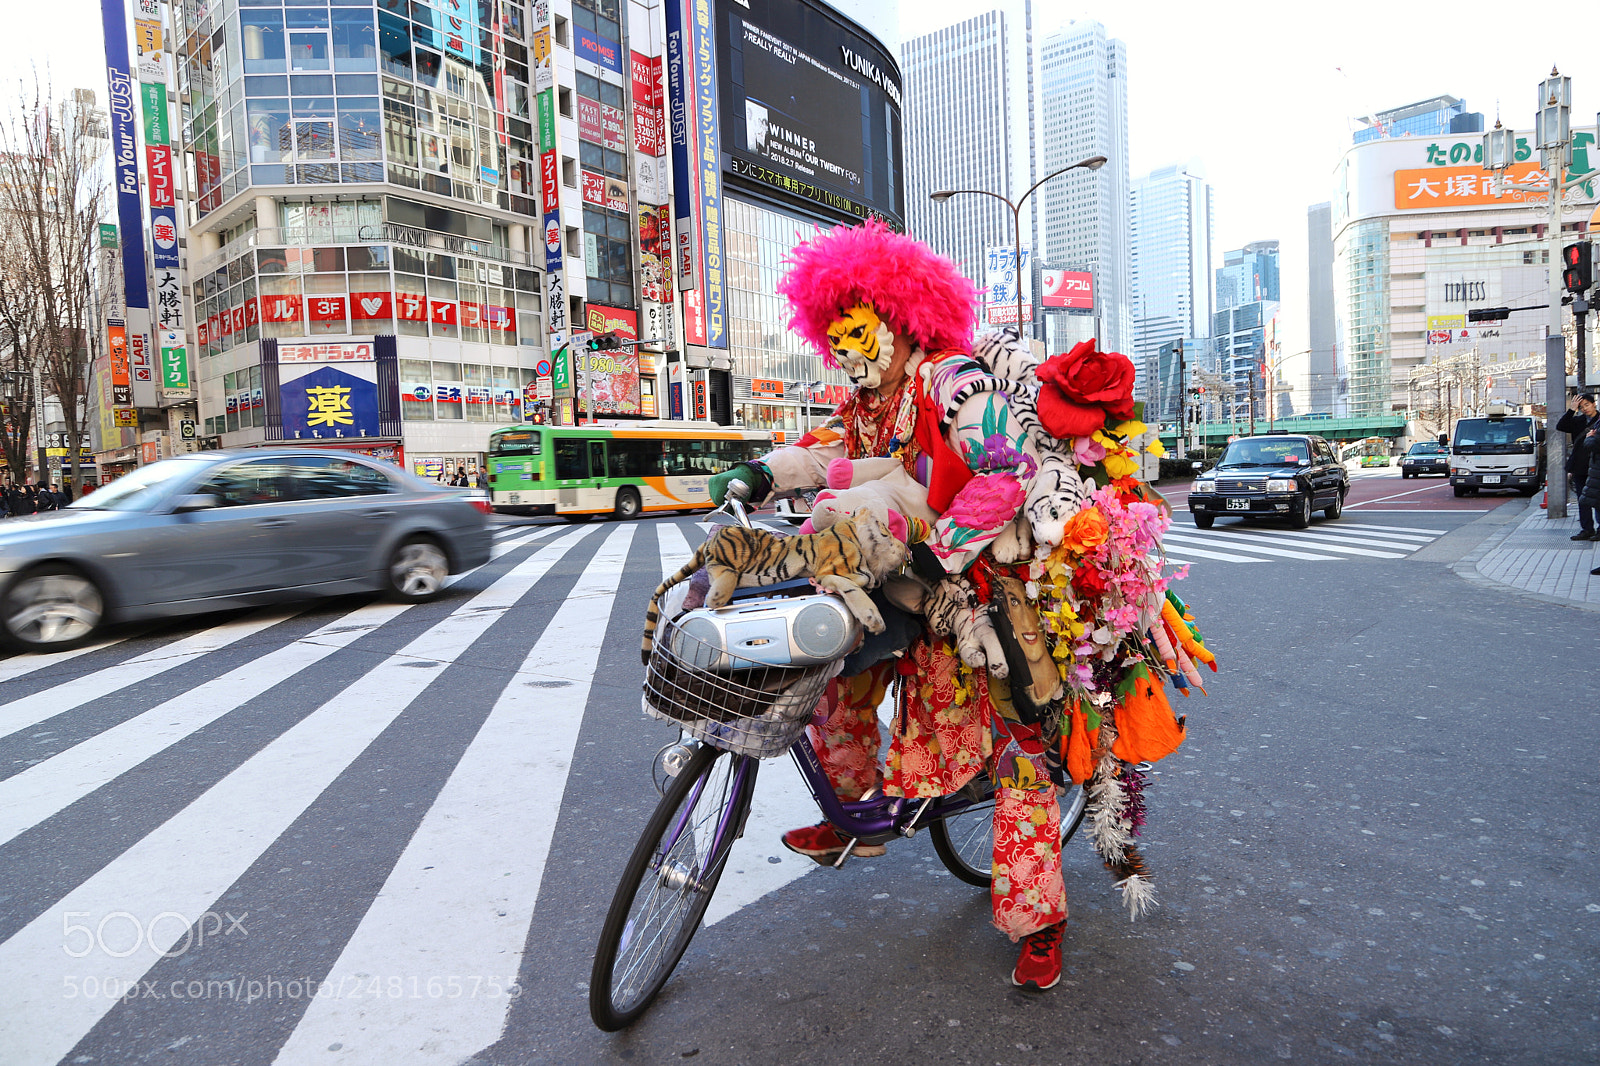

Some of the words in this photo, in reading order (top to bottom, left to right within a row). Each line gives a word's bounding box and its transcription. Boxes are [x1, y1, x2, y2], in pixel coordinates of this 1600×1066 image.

[581, 37, 615, 60] PROMISE
[668, 30, 680, 55] For
[748, 32, 773, 52] REALLY
[773, 46, 797, 65] REALLY
[632, 61, 650, 75] FAST
[841, 45, 882, 87] YUNIKA
[632, 72, 651, 86] NAIL
[108, 67, 134, 122] JUST
[580, 104, 599, 116] FAST
[581, 113, 599, 126] NAIL
[602, 105, 624, 120] ネイル
[670, 97, 686, 146] JUST
[645, 117, 654, 128] 03
[656, 108, 665, 155] まつげ本舗
[768, 122, 816, 153] WINNER
[769, 139, 783, 152] NEW
[783, 145, 802, 159] ALBUM
[819, 158, 845, 177] TWENTY
[794, 161, 815, 176] Release
[119, 171, 138, 195] For
[151, 149, 171, 203] アイフル
[544, 154, 557, 208] アイフル
[582, 173, 605, 190] まつげ
[585, 188, 602, 203] 本舗
[155, 224, 174, 241] 薬
[546, 228, 560, 245] 薬
[683, 247, 691, 276] LABI
[988, 247, 1029, 271] カラオケ
[1004, 270, 1013, 282] の
[1066, 279, 1091, 291] アコム
[158, 271, 183, 327] 大勝軒
[549, 273, 566, 329] 大勝軒
[993, 283, 1026, 303] 鉄人
[1063, 298, 1073, 306] 2F
[1445, 276, 1485, 308] TIPNESS
[317, 301, 340, 315] 3F
[403, 298, 511, 328] アイフル
[131, 334, 145, 366] LABI
[168, 350, 182, 382] レイク
[556, 355, 565, 384] レイク
[305, 385, 355, 427] 薬
[673, 385, 681, 414] PROMISE
[815, 385, 850, 404] LABI
